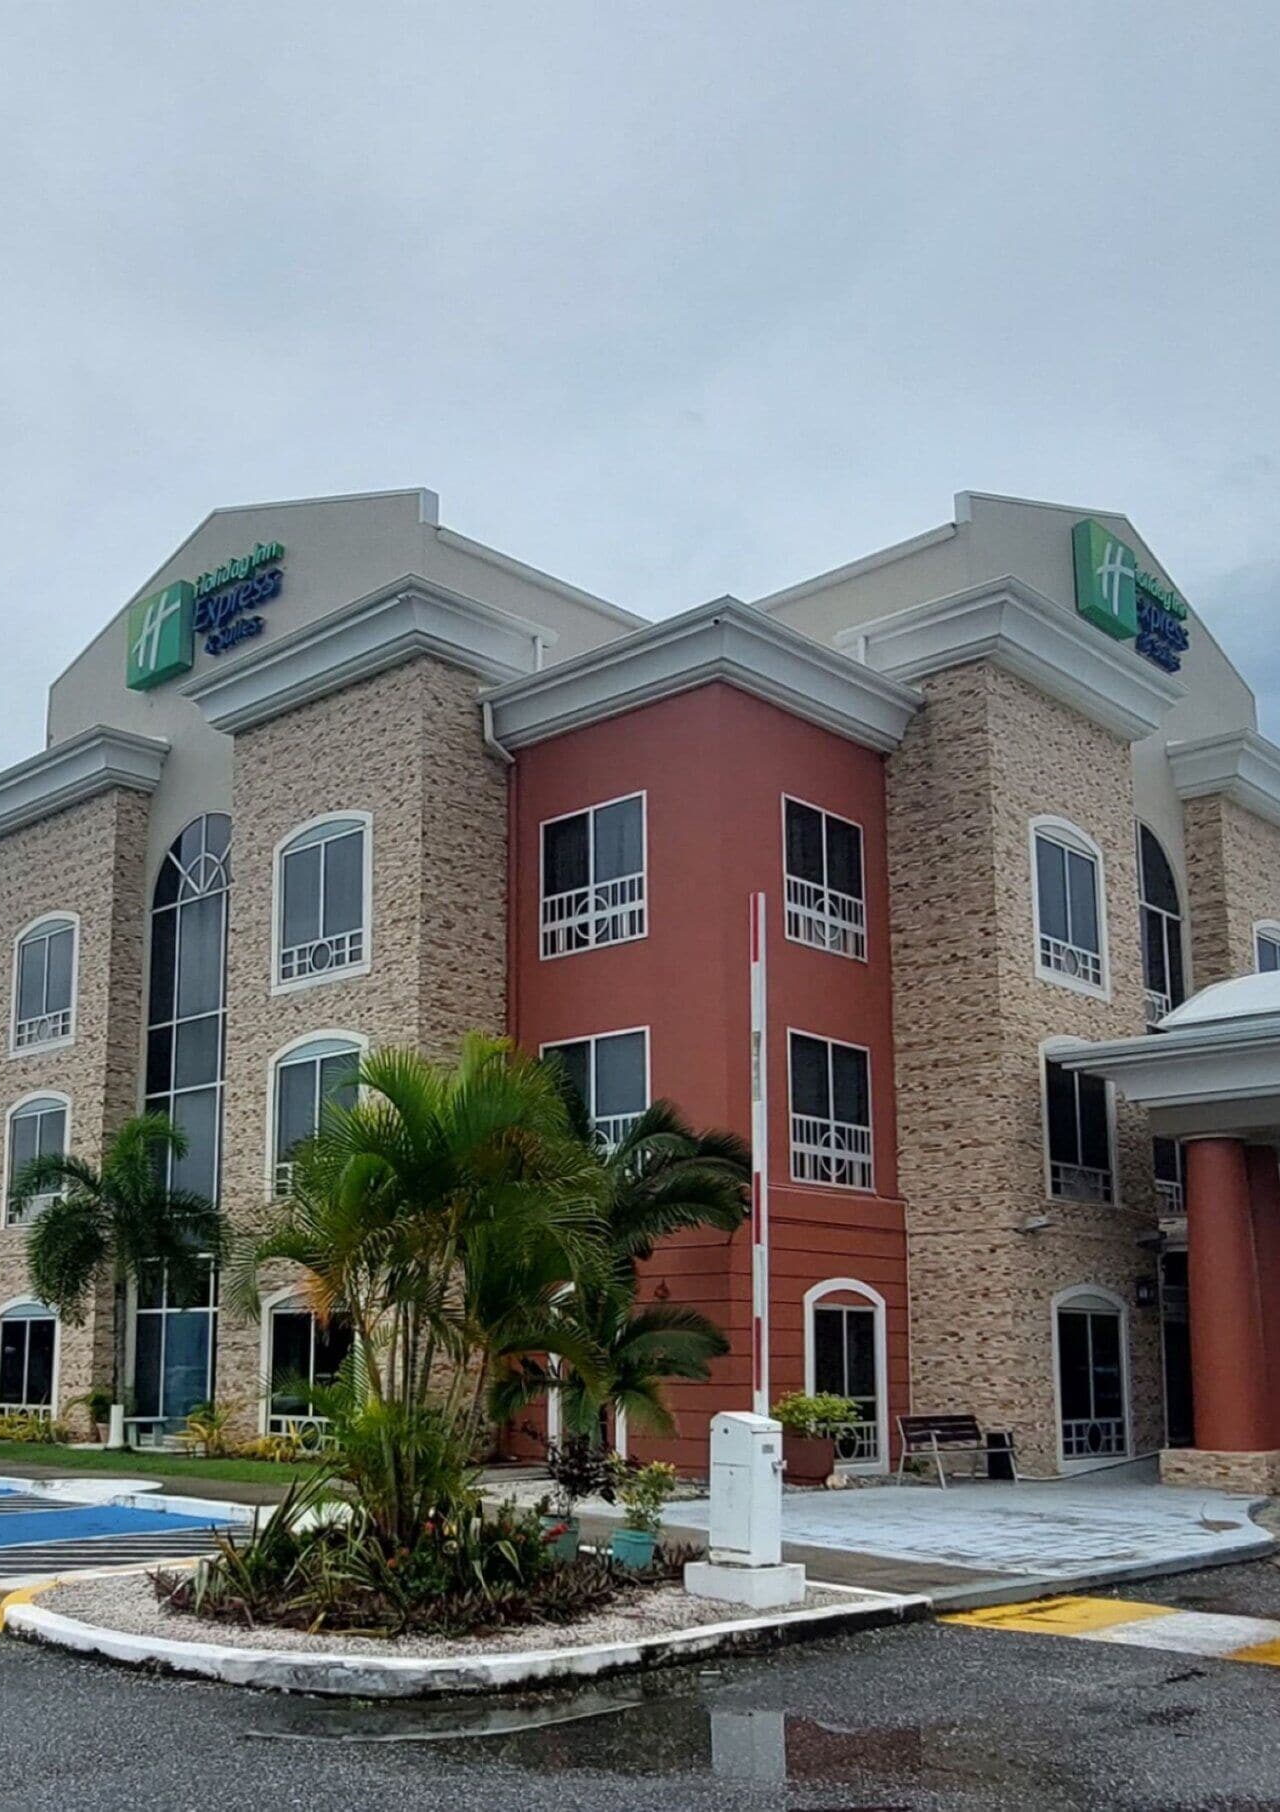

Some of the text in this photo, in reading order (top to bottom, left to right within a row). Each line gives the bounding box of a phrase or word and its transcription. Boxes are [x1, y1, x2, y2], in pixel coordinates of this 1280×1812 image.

[193, 542, 283, 598] Holiday Inn
[1135, 564, 1172, 611] oliday
[193, 568, 283, 632] Express
[1136, 597, 1189, 652] xpre
